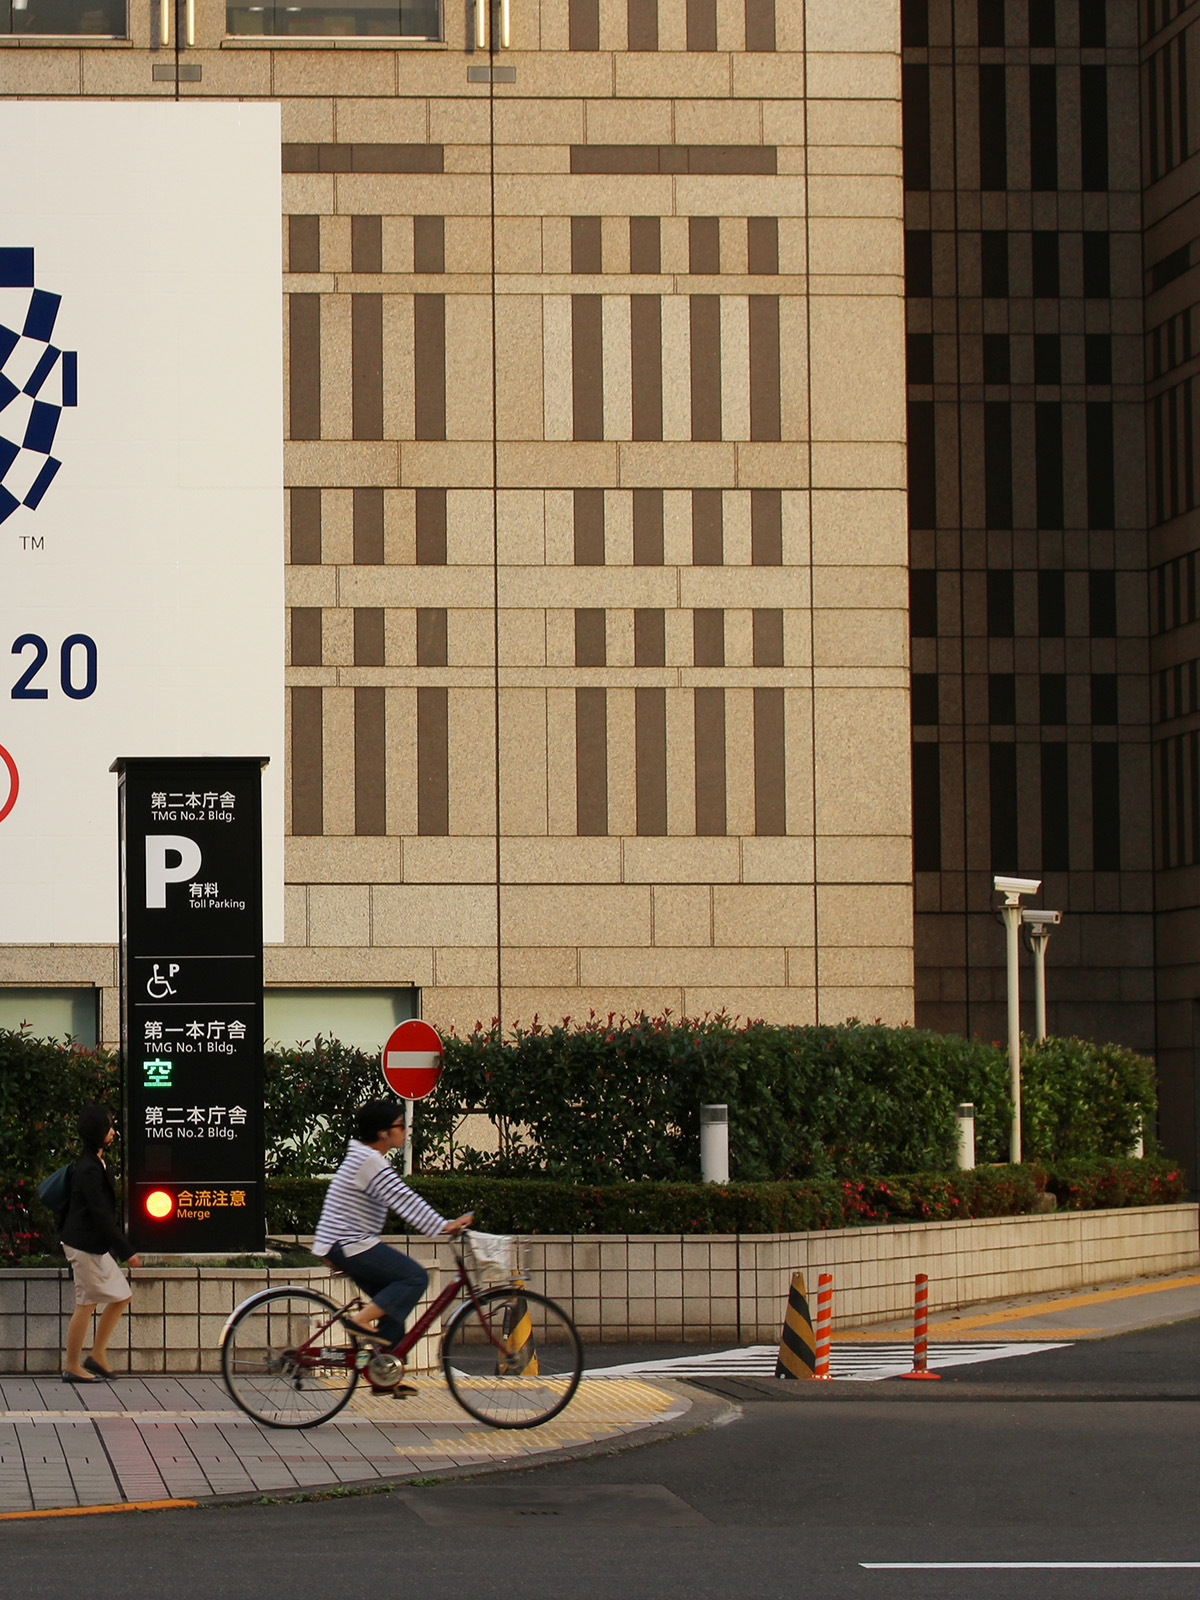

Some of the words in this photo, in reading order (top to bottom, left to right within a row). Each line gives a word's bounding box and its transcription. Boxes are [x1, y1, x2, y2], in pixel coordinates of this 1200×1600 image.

[19, 536, 45, 550] TM
[152, 791, 235, 808] 第二本庁舎
[152, 811, 176, 820] TMG
[181, 811, 204, 820] No.2
[209, 811, 235, 822] Bldg.
[145, 834, 202, 909] P
[189, 882, 218, 897] 有料
[189, 899, 206, 908] Toll
[209, 899, 245, 910] Parking
[170, 964, 179, 977] P
[145, 1020, 246, 1040] 第一本庁舎
[145, 1042, 172, 1052] TMG
[177, 1042, 201, 1052] No.1
[208, 1042, 236, 1054] Bldg.
[144, 1058, 172, 1086] 空
[145, 1106, 247, 1125] 第二本庁舎
[145, 1128, 172, 1137] TMG
[178, 1127, 203, 1137] No.2
[208, 1127, 237, 1140] Bldg.
[177, 1190, 246, 1207] 合流注意
[177, 1209, 211, 1220] Merge
